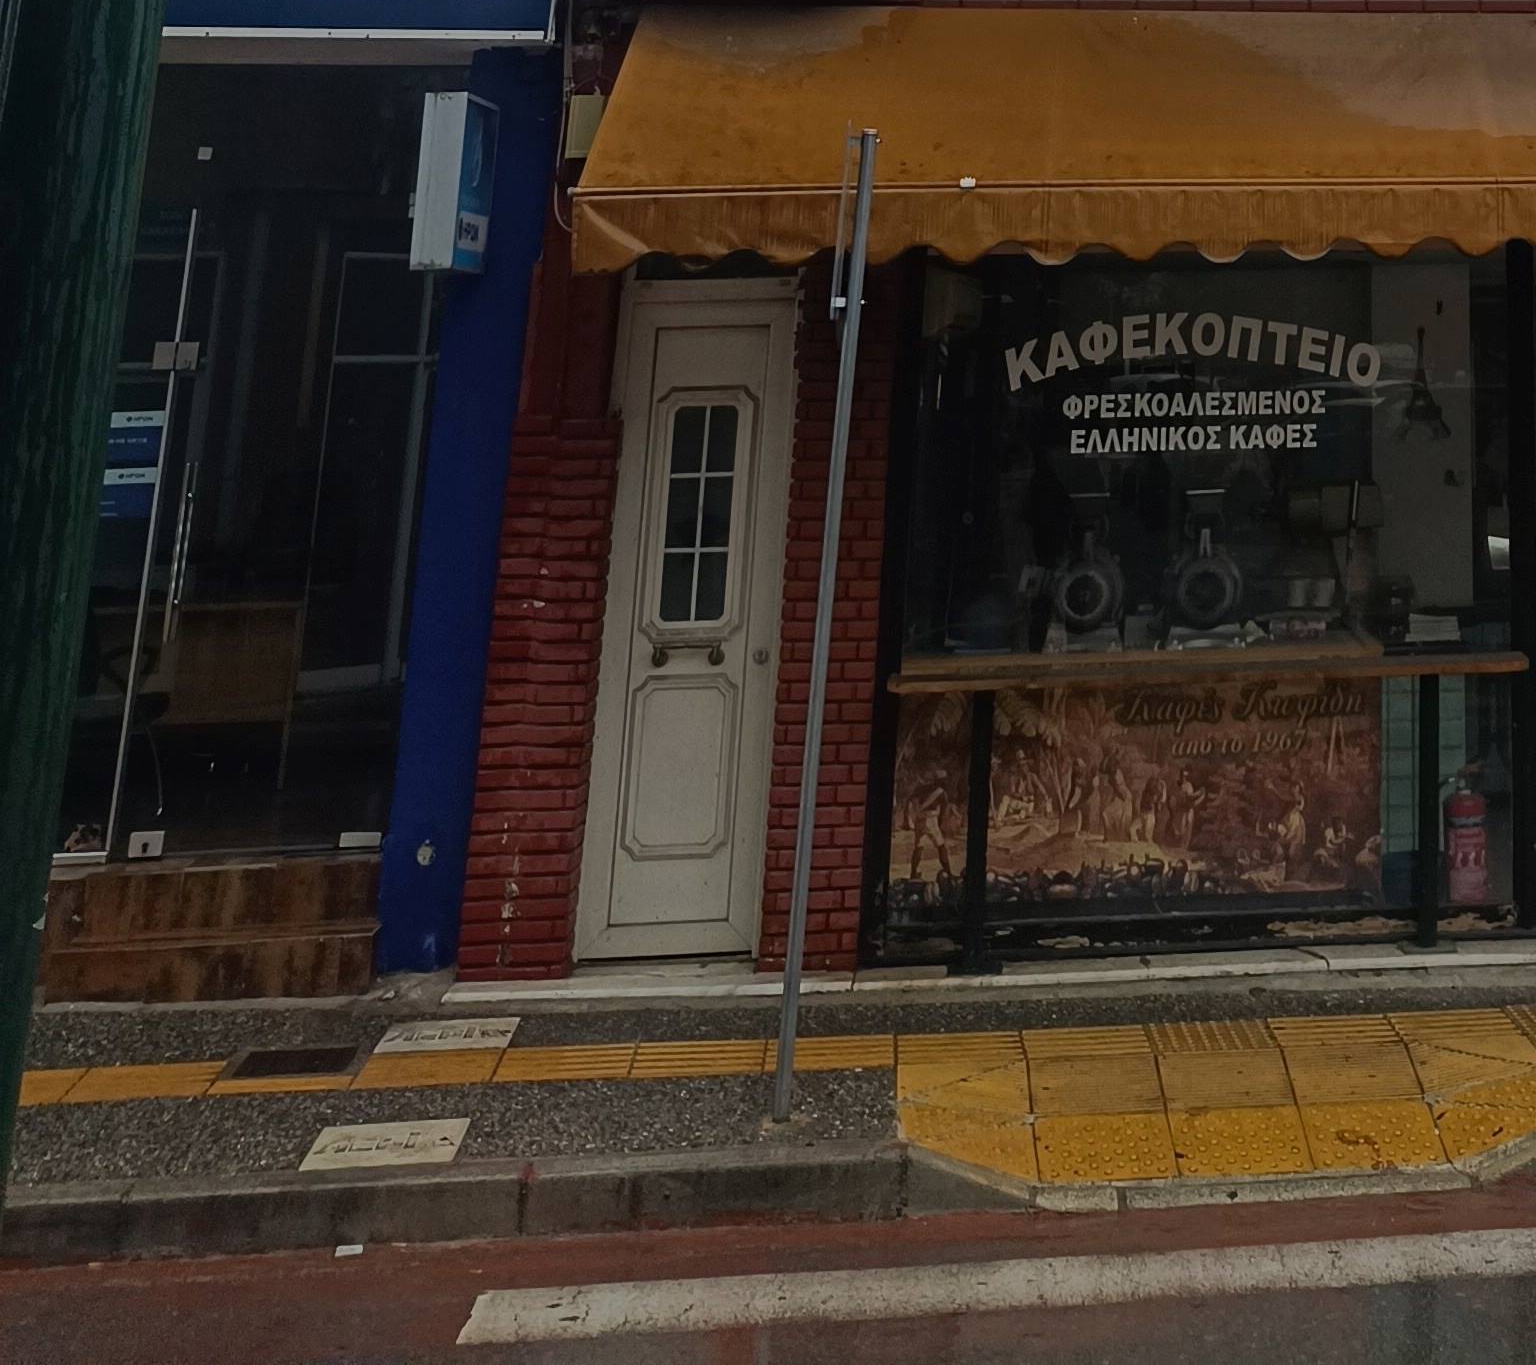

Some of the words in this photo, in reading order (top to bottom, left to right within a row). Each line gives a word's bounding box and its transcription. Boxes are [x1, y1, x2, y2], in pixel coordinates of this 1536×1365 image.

[1005, 312, 1381, 391] ΚΑΦΕΚΟΠΤΕΙΟ
[1062, 389, 1326, 419] ΦΡΕΣΚΟΑΛΕΣΜΕΝΟΣ
[1070, 425, 1221, 454] ΕΛΛΗΝΙΚΟΣ
[1229, 423, 1318, 451] ΚΑΦΕΣ
[1252, 728, 1308, 753] 1967
